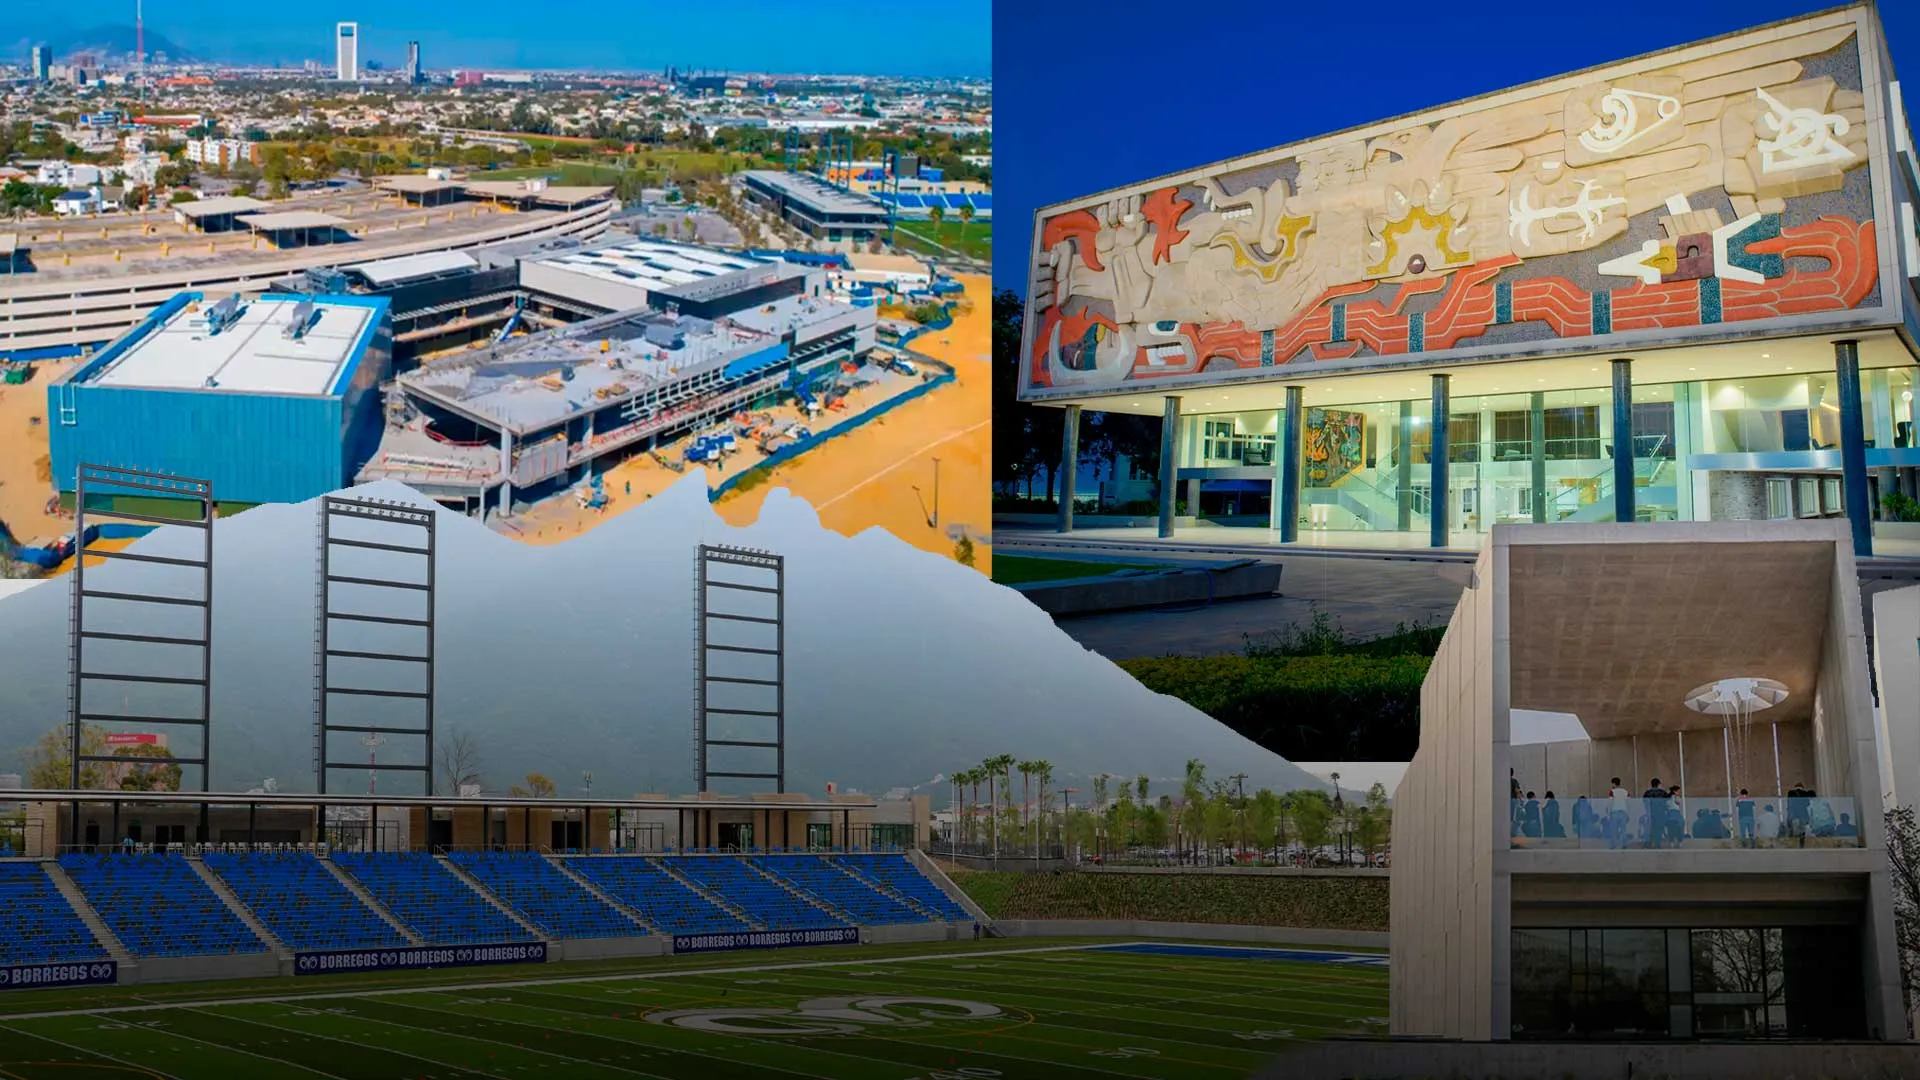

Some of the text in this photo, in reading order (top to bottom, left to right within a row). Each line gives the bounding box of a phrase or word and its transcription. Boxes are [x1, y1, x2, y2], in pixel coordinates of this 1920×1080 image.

[691, 930, 843, 949] BORREGOS BORREGOS BORREGOS
[320, 947, 526, 969] BORREGOS BORREGOS BORREGOS
[12, 965, 88, 984] BORREGOS
